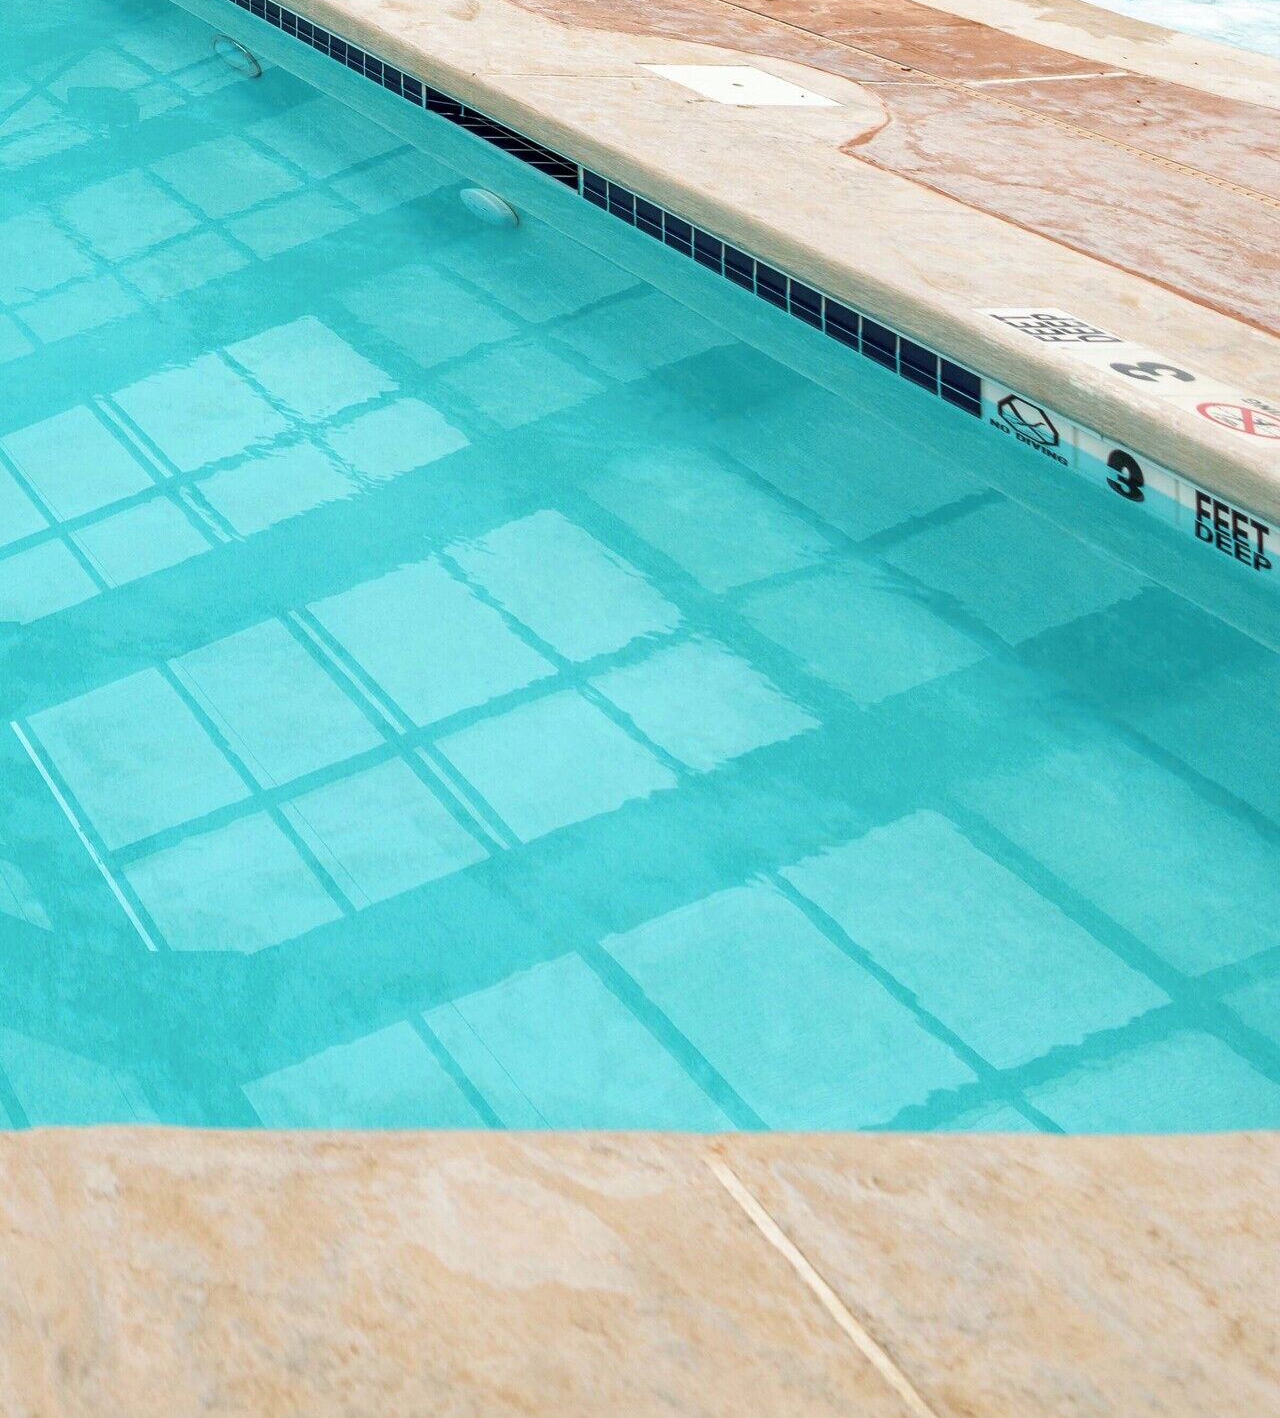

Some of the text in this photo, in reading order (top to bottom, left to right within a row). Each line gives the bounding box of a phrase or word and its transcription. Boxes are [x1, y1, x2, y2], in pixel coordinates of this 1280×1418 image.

[989, 313, 1082, 342] FEET
[1030, 313, 1124, 343] DEEP
[1109, 361, 1196, 383] 3
[990, 418, 1069, 467] NO DIVING
[1106, 448, 1145, 503] 3
[1194, 519, 1273, 572] DEEP
[1195, 488, 1270, 555] FEET
